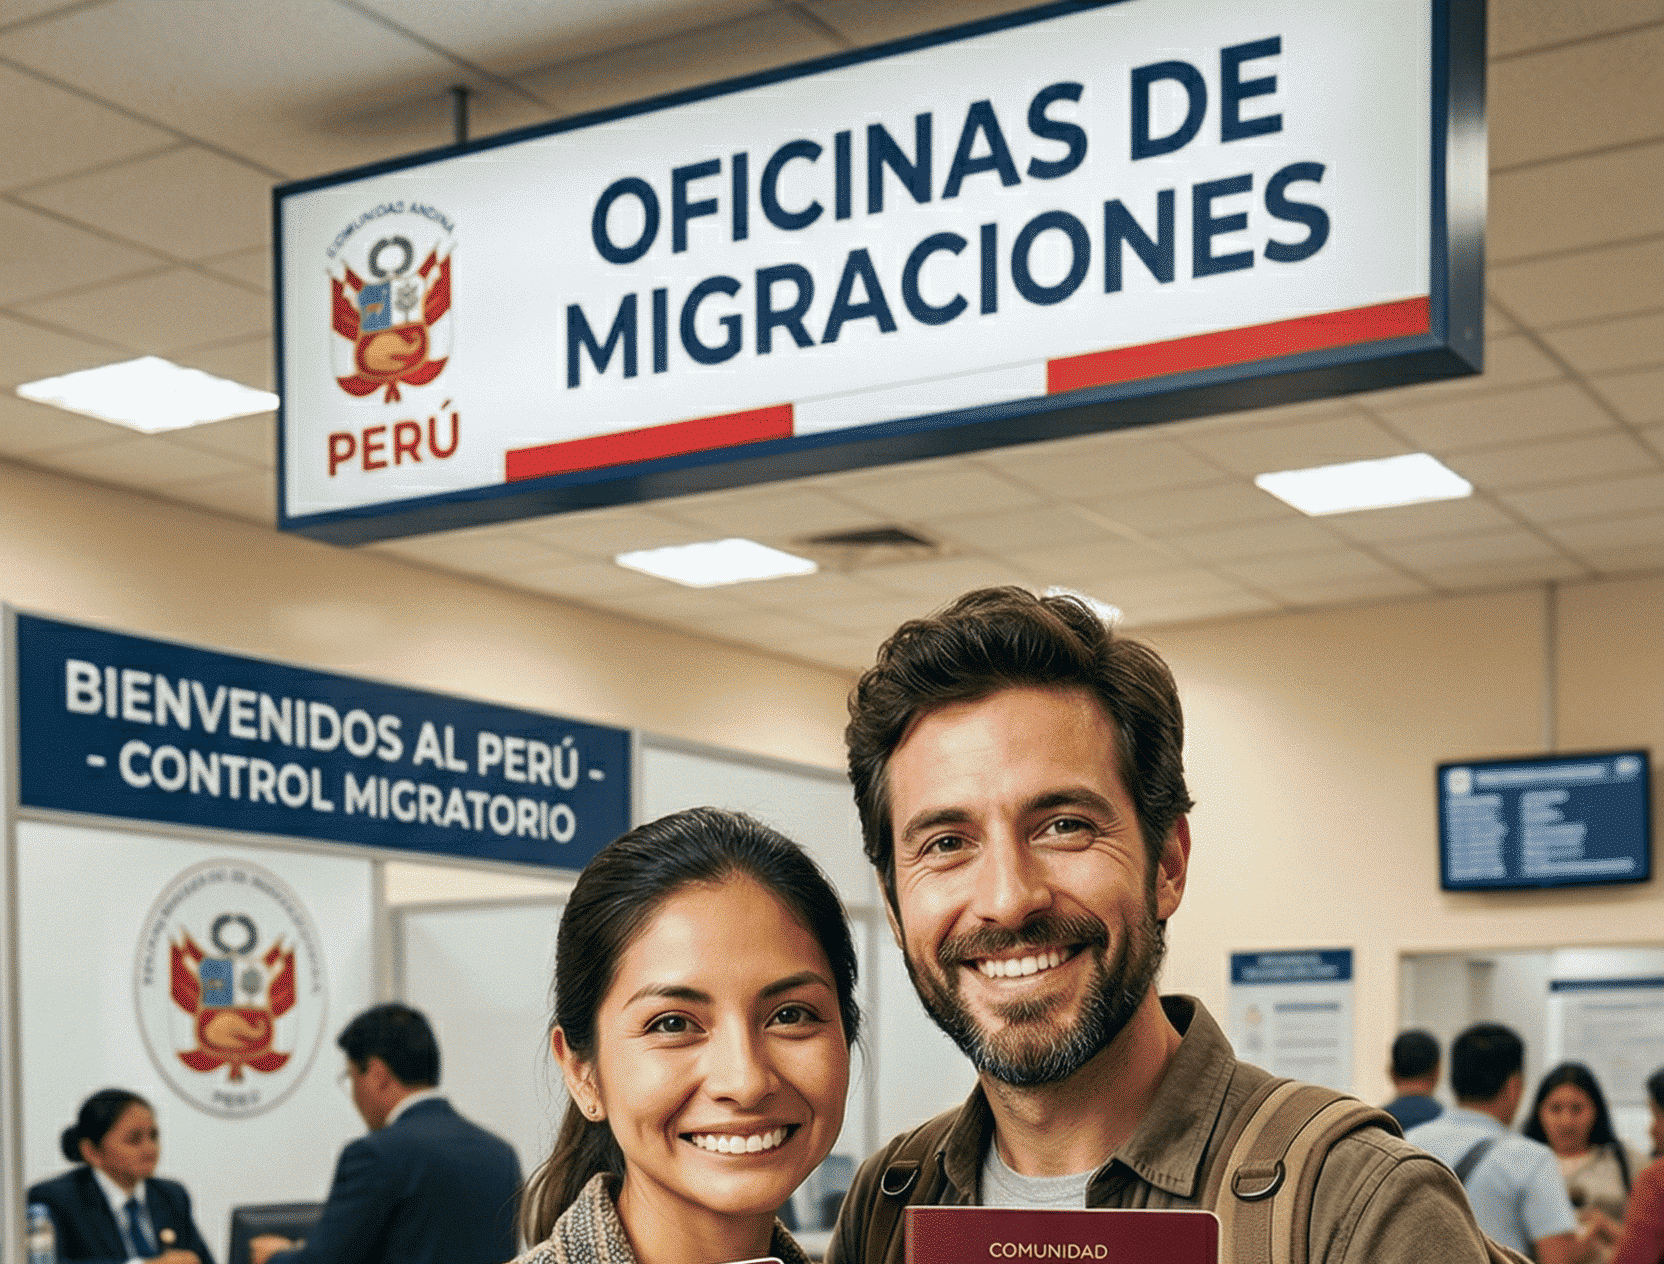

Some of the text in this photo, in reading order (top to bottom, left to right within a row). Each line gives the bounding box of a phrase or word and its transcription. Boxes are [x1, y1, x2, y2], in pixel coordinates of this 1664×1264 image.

[591, 34, 1283, 265] OFICINAS DE
[566, 160, 1331, 389] MIGRACIONES
[328, 399, 459, 477] PERÚ
[65, 659, 403, 762] BIENVENIDOS
[413, 721, 468, 773] AL
[477, 736, 579, 790] PERÚ
[119, 740, 334, 813] CONTROL
[345, 772, 577, 843] MIGRATORIO
[989, 1242, 1108, 1260] COMUNIDAD
